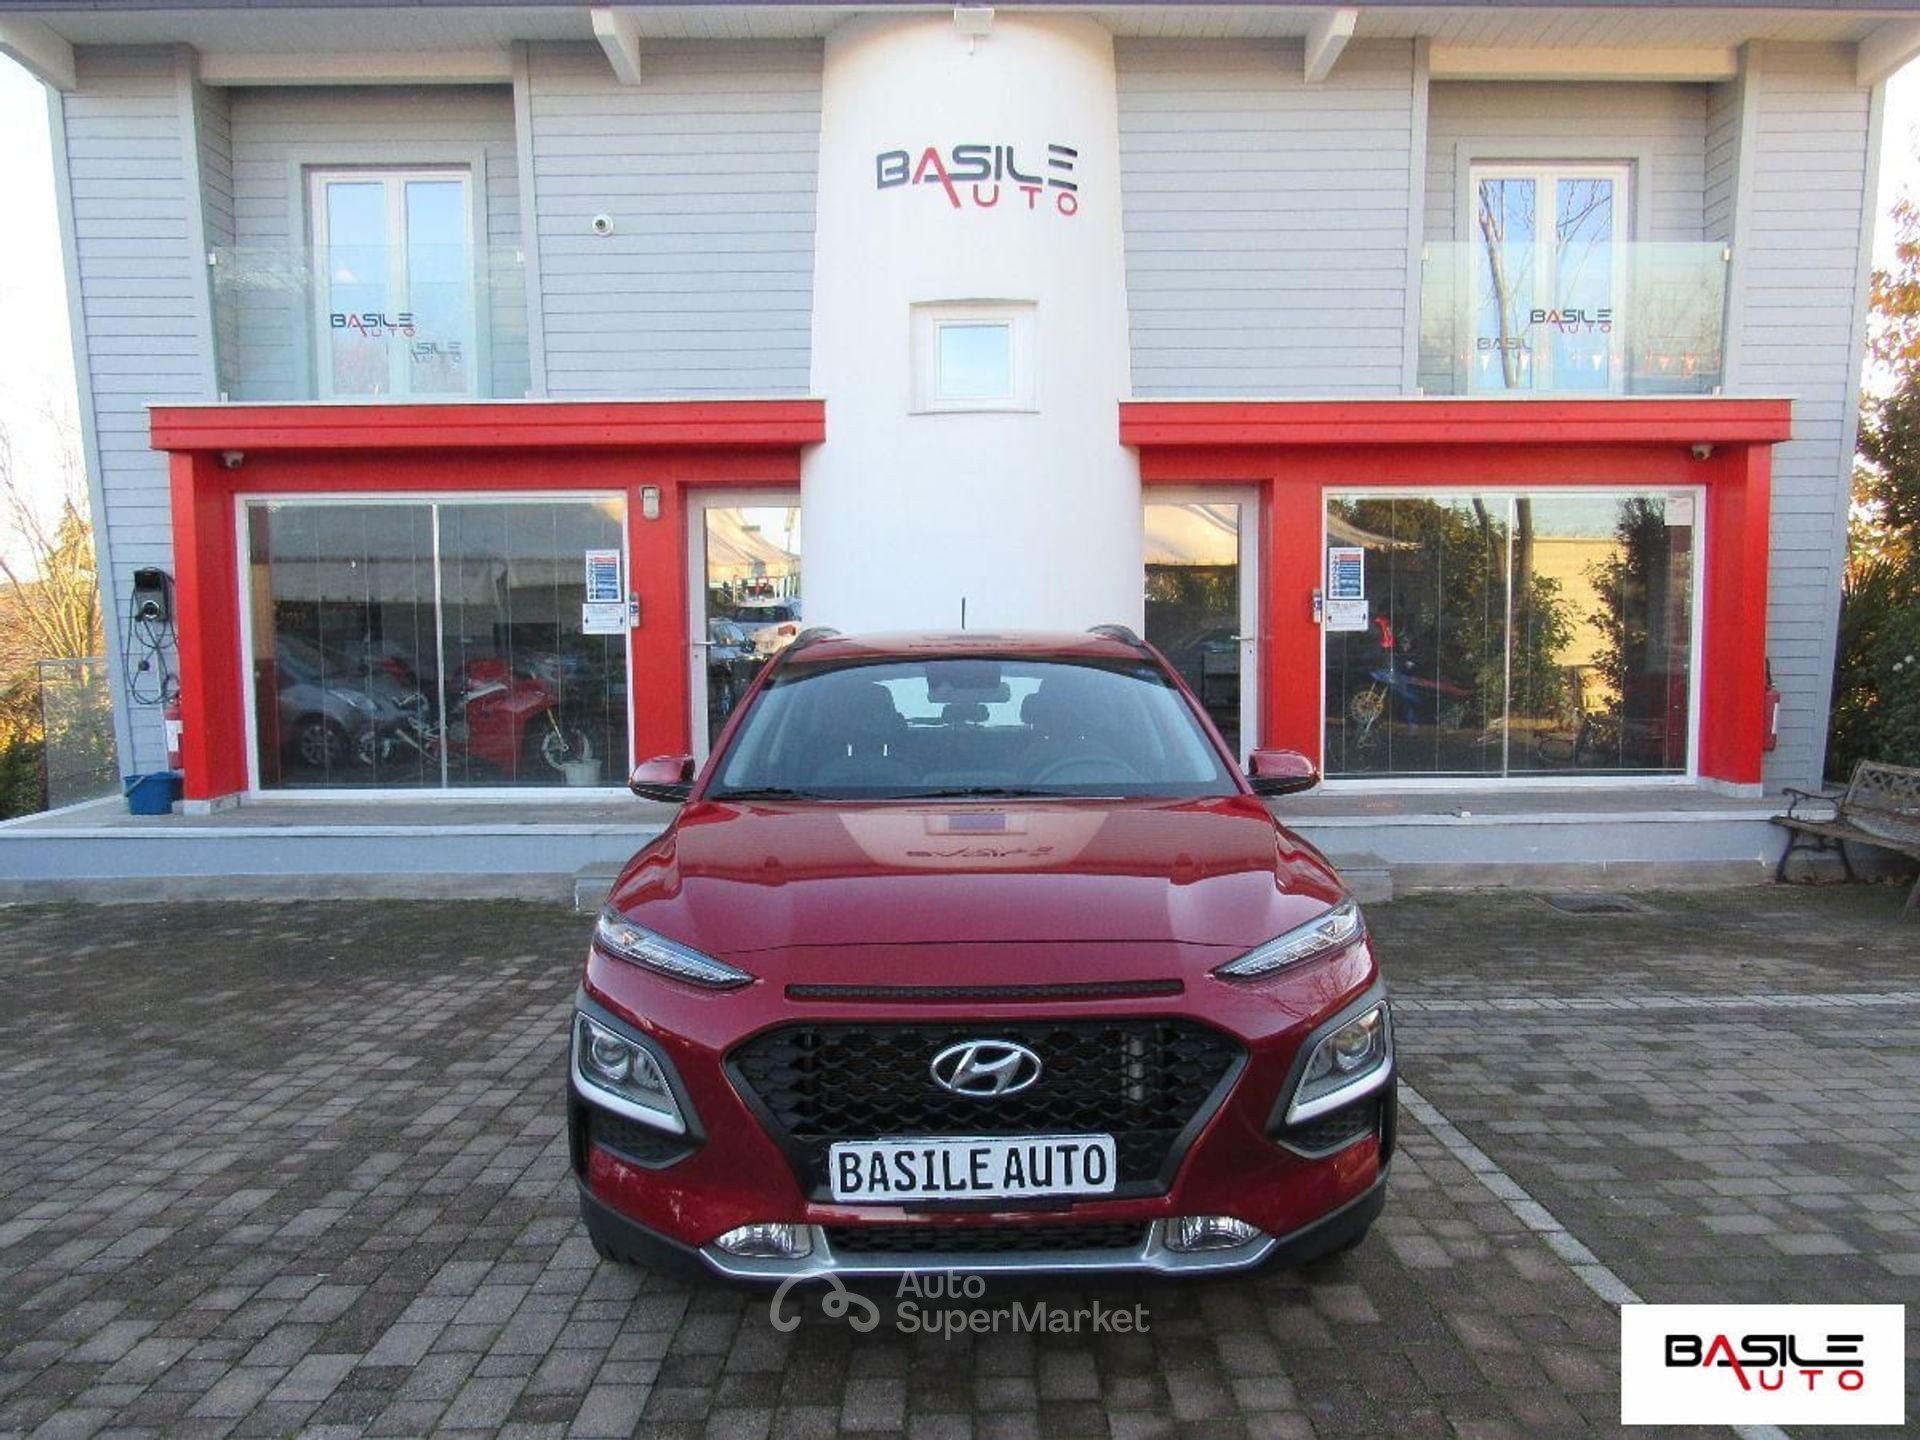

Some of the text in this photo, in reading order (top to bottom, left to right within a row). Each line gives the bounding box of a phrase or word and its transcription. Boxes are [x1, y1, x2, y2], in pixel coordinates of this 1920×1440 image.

[876, 144, 1079, 208] BASILE
[330, 313, 414, 337] BASILE
[1530, 309, 1613, 334] BASILE
[838, 1144, 1107, 1193] BASILE AUTO
